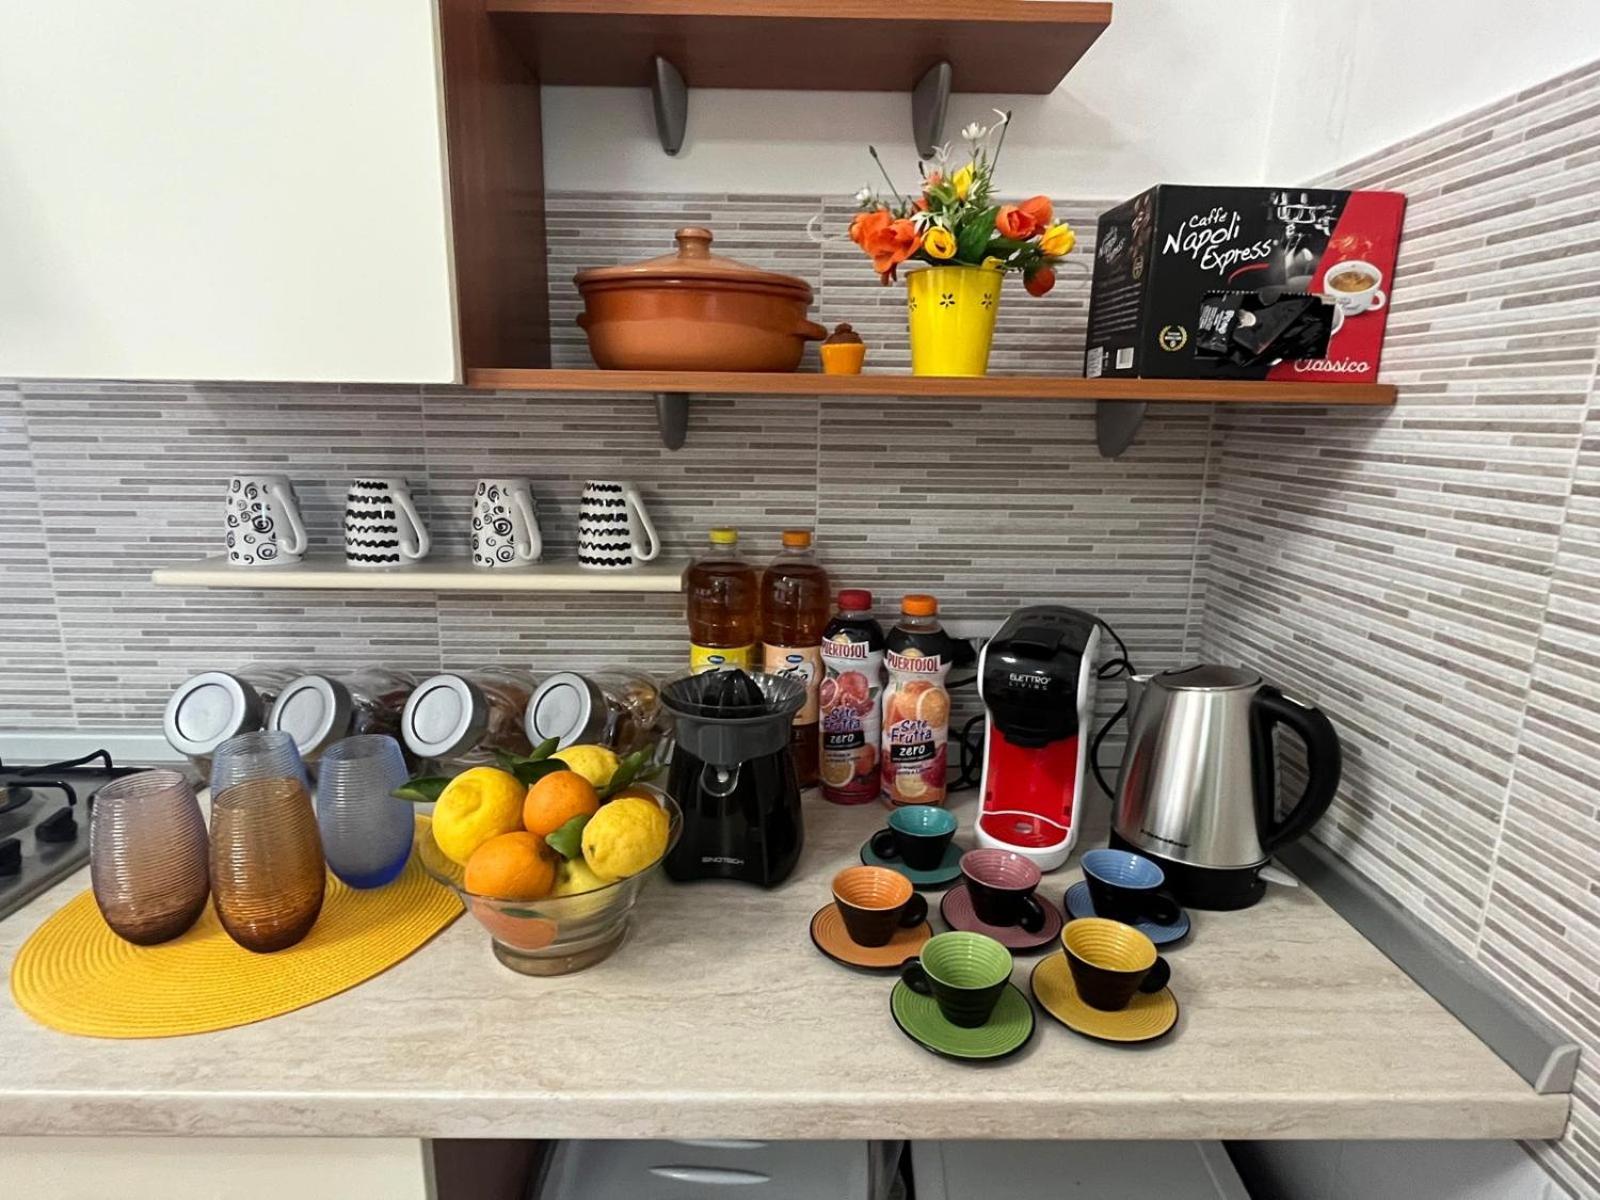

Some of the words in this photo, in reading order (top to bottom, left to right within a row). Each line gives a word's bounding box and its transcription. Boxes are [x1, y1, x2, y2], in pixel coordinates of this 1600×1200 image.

[1161, 211, 1241, 260] Napoli
[1200, 239, 1273, 275] Express
[822, 641, 868, 658] PUERTOSOL
[888, 652, 939, 672] PUERTOSOL
[830, 733, 855, 744] zero
[891, 727, 932, 744] Frutta
[898, 744, 926, 757] zero
